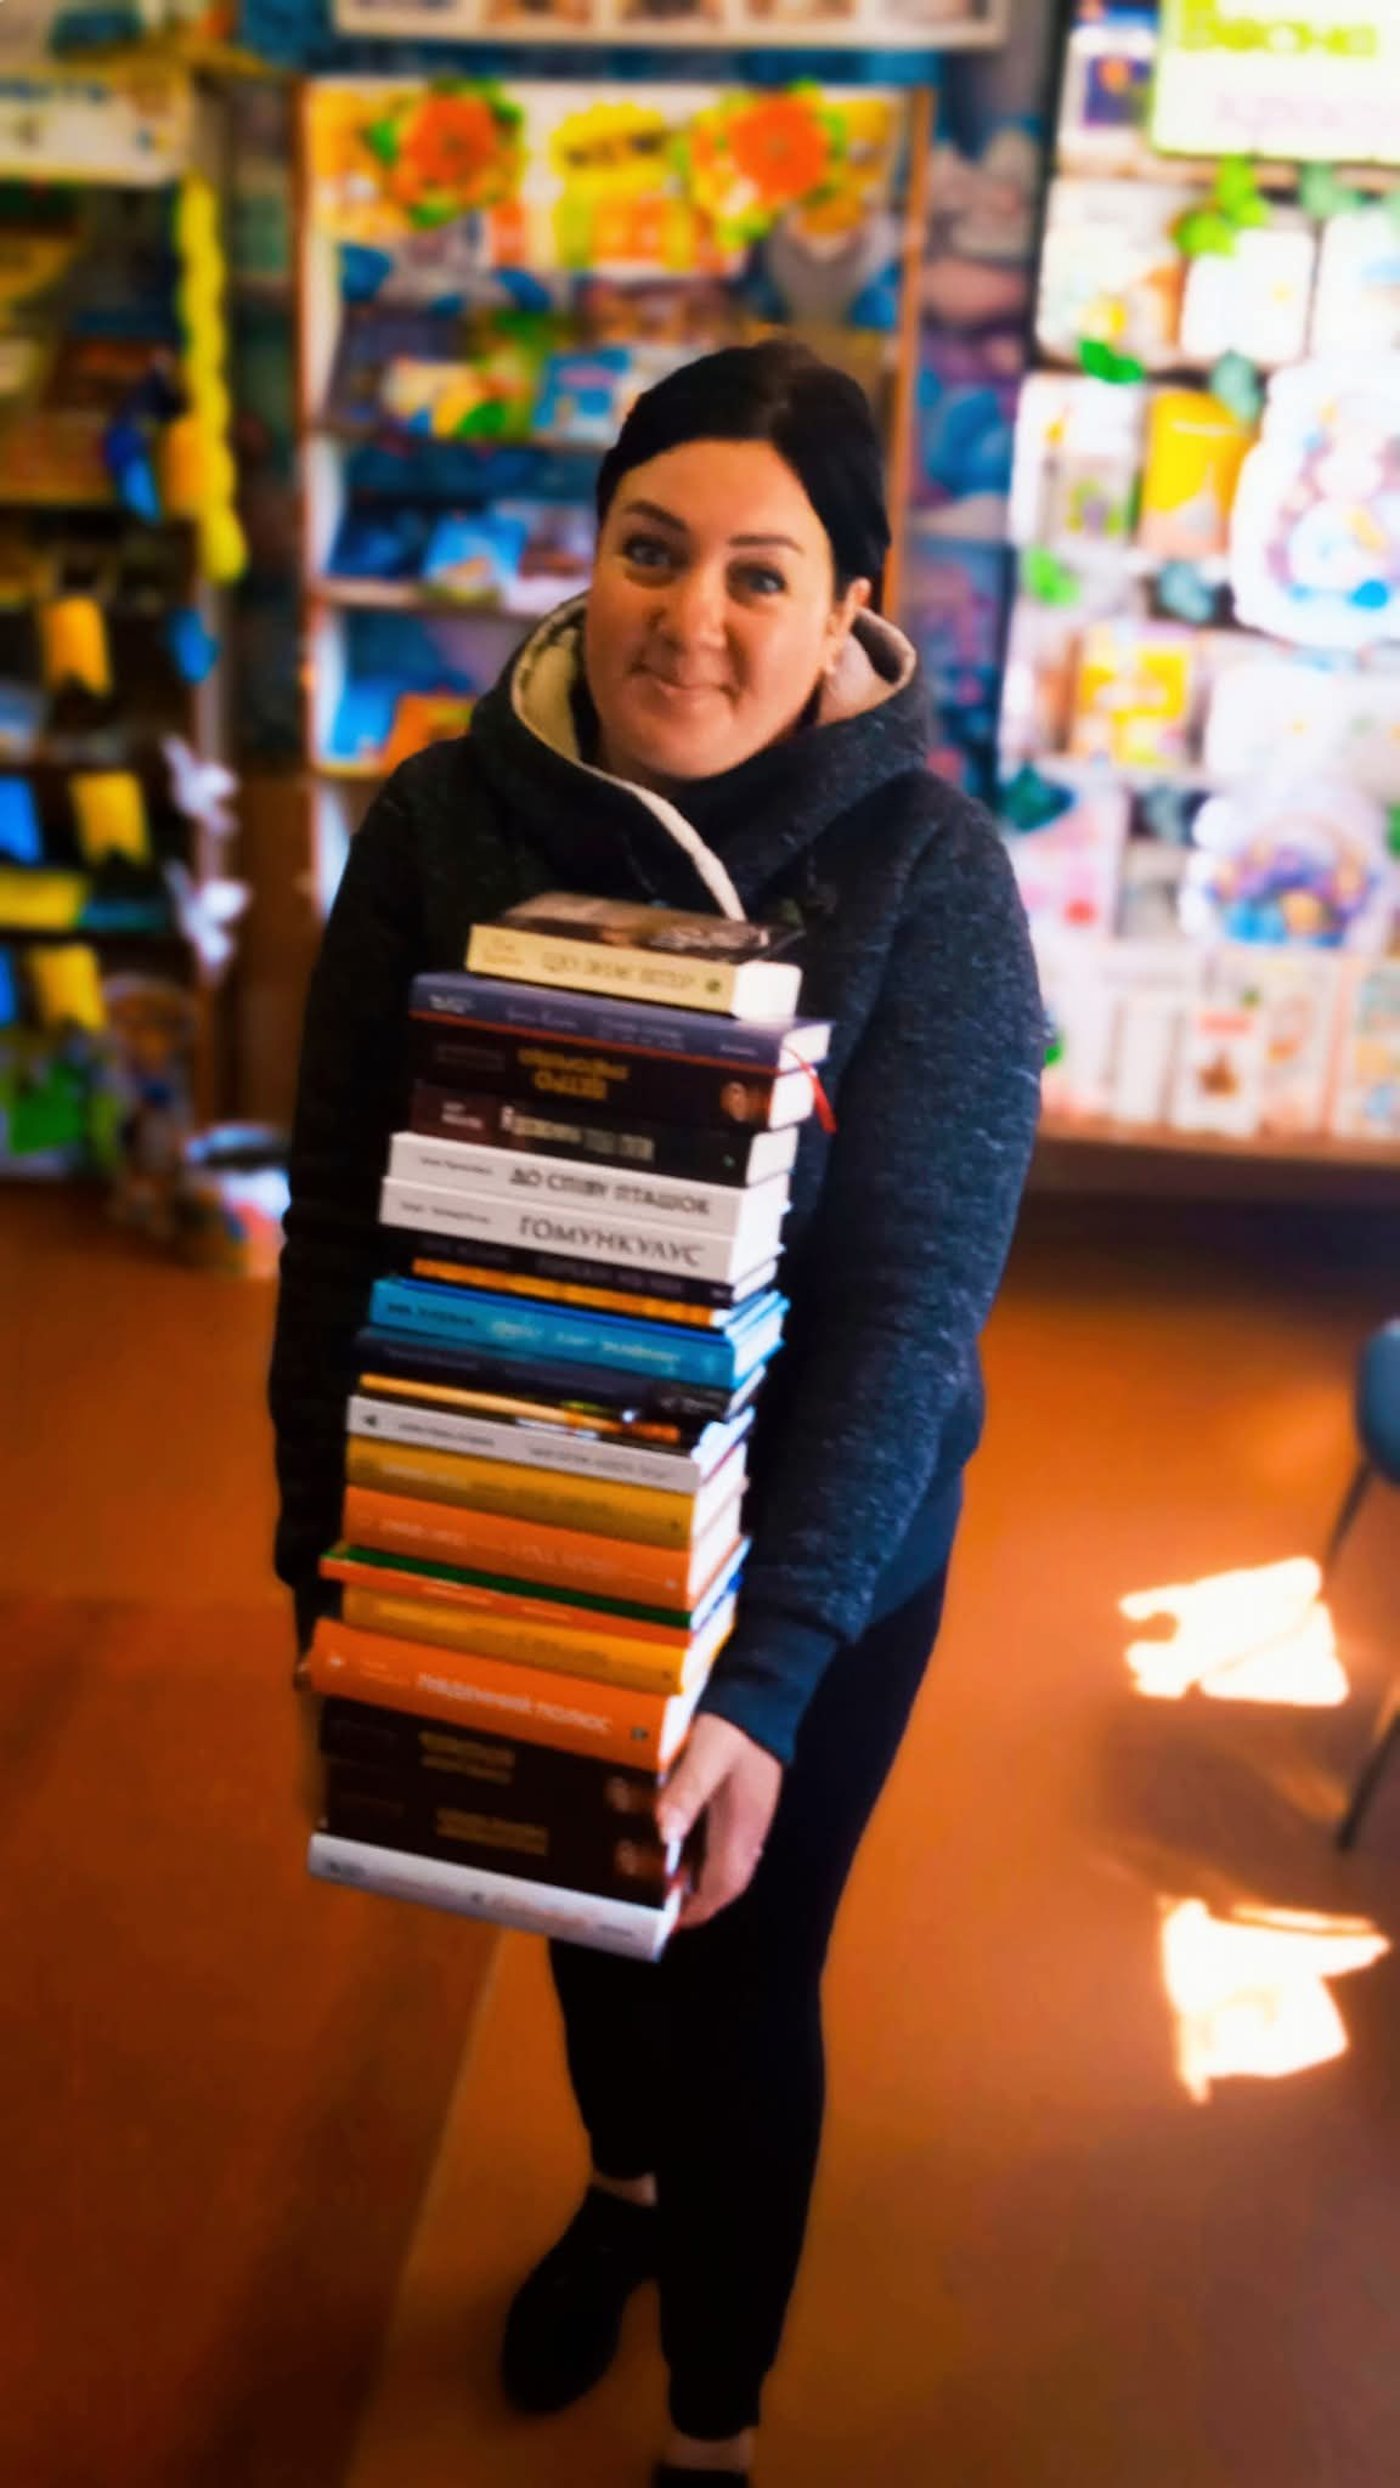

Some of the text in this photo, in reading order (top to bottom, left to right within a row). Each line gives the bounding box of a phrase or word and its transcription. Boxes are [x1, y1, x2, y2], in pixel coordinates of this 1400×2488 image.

[511, 1166, 542, 1187] ДО
[614, 1186, 709, 1215] ПТАШОК
[519, 1216, 703, 1267] ГОМУНКУЛУС
